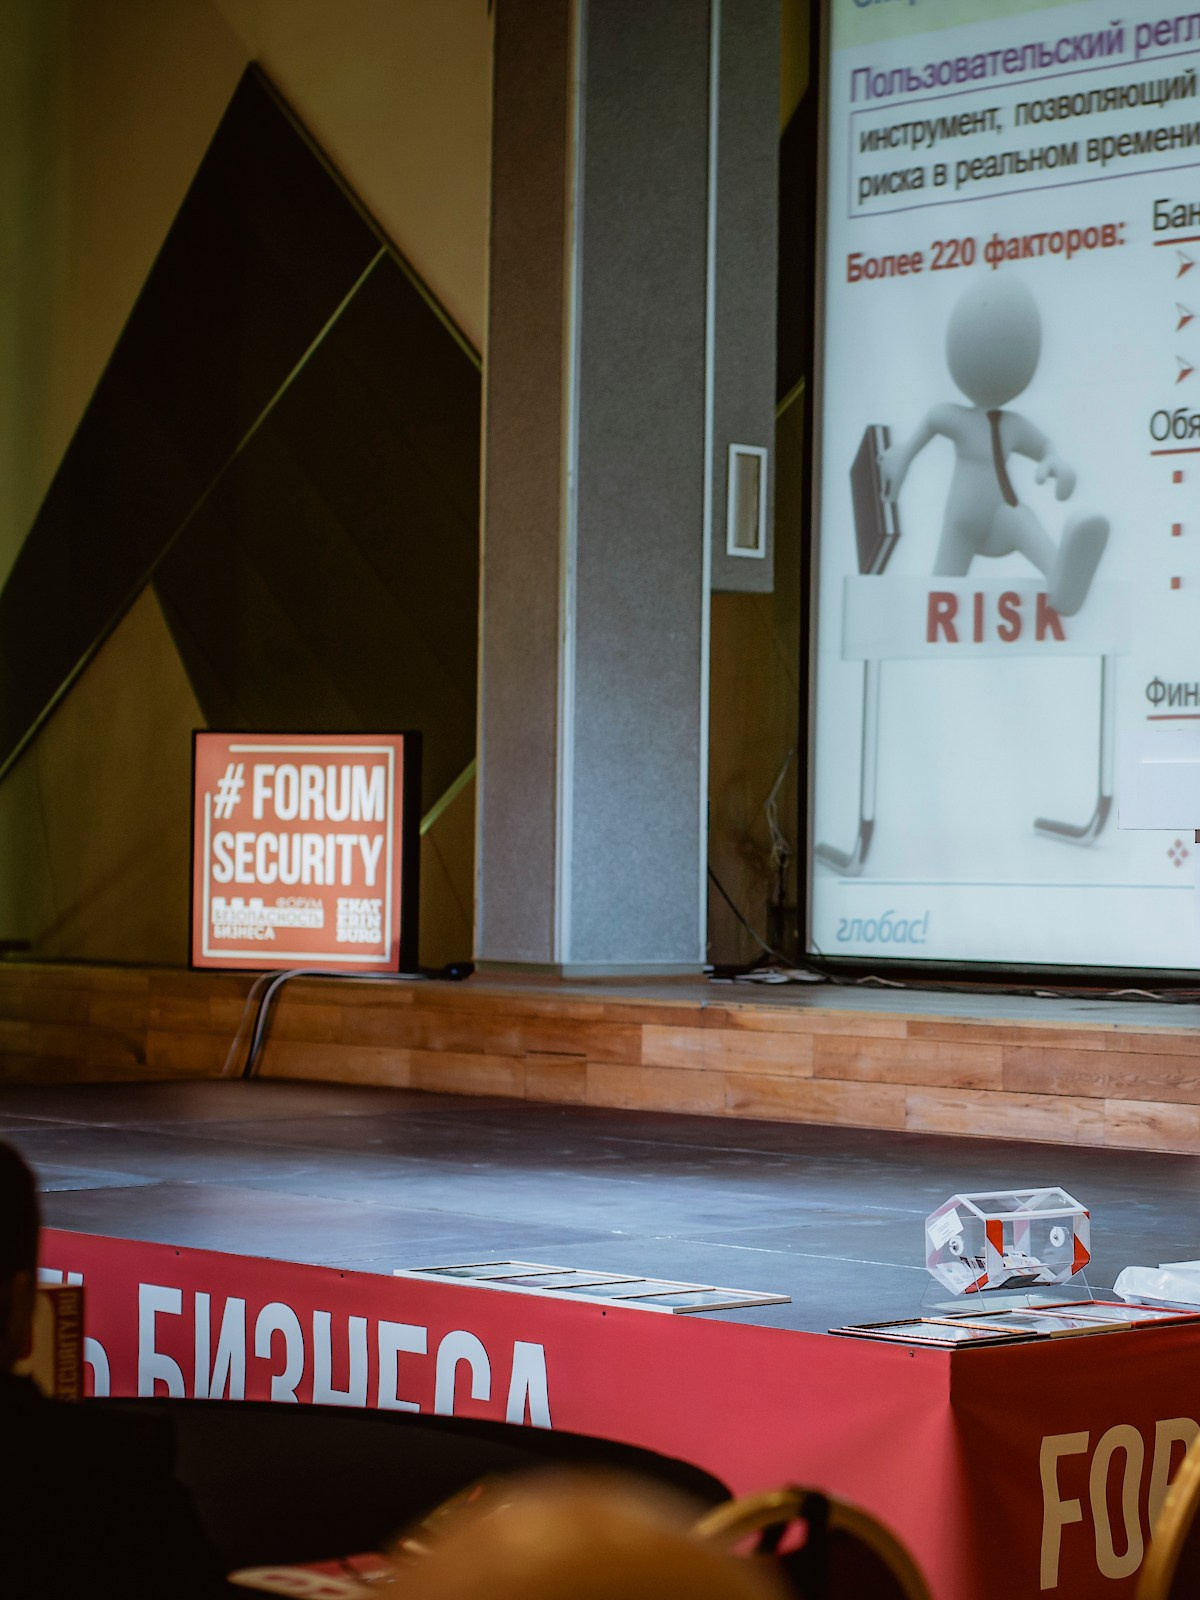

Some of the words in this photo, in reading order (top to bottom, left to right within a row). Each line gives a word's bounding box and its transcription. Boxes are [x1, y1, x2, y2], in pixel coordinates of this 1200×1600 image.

[850, 20, 1124, 103] Пользовательский
[859, 107, 1004, 153] инструмент,
[1014, 69, 1197, 127] позволяющий
[858, 164, 925, 205] риска
[933, 161, 948, 188] в
[955, 139, 1079, 190] реальном
[846, 248, 923, 283] Более
[929, 237, 975, 272] 220
[983, 221, 1126, 271] факторов:
[926, 590, 1067, 644] RISK
[252, 763, 386, 822] FORUM
[212, 830, 384, 887] SECURITY
